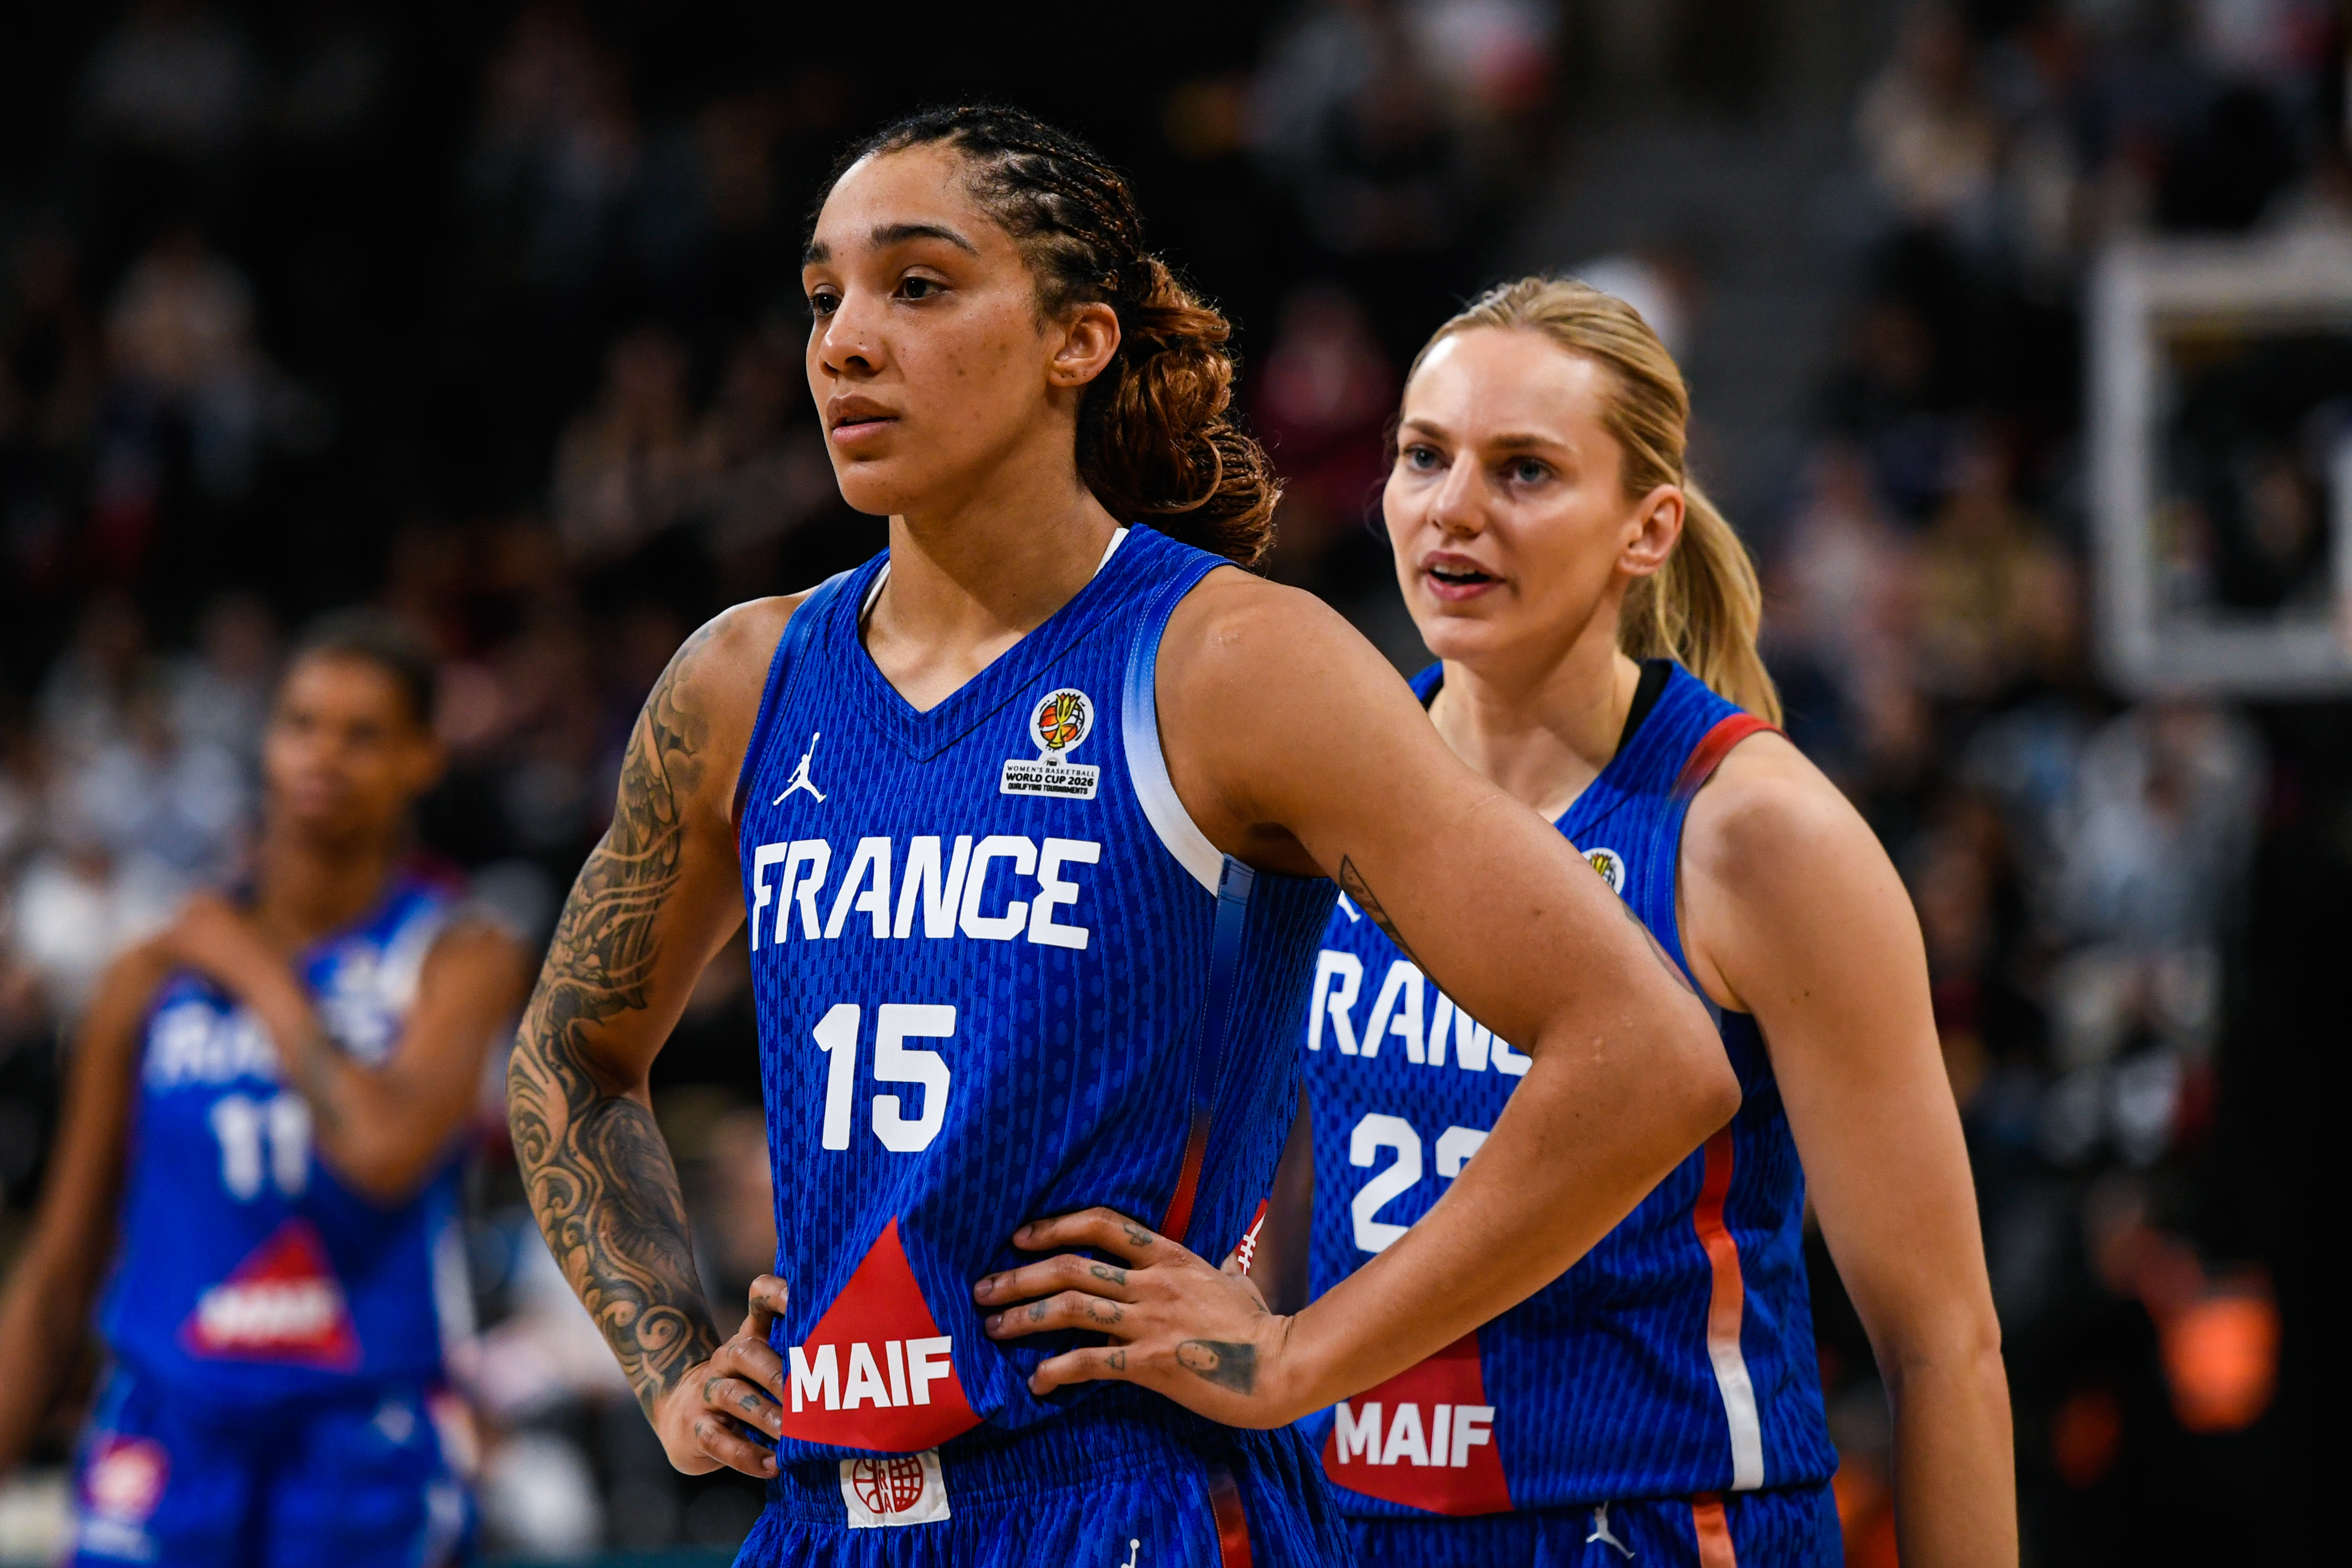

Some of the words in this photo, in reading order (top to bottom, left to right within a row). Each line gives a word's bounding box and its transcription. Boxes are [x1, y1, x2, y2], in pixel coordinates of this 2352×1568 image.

[1006, 772, 1042, 782] WORLD
[1045, 775, 1066, 784] CUP
[1068, 776, 1094, 787] 2026
[1008, 782, 1041, 791] QUALIFYING
[1043, 784, 1088, 795] TOURNAMENTS
[1045, 767, 1095, 777] BASKETBALL
[752, 835, 1101, 951] FRANCE
[1307, 949, 1534, 1077] RAN
[812, 1003, 957, 1153] 15
[789, 1335, 952, 1413] MAIF
[1335, 1402, 1496, 1468] MAIF
